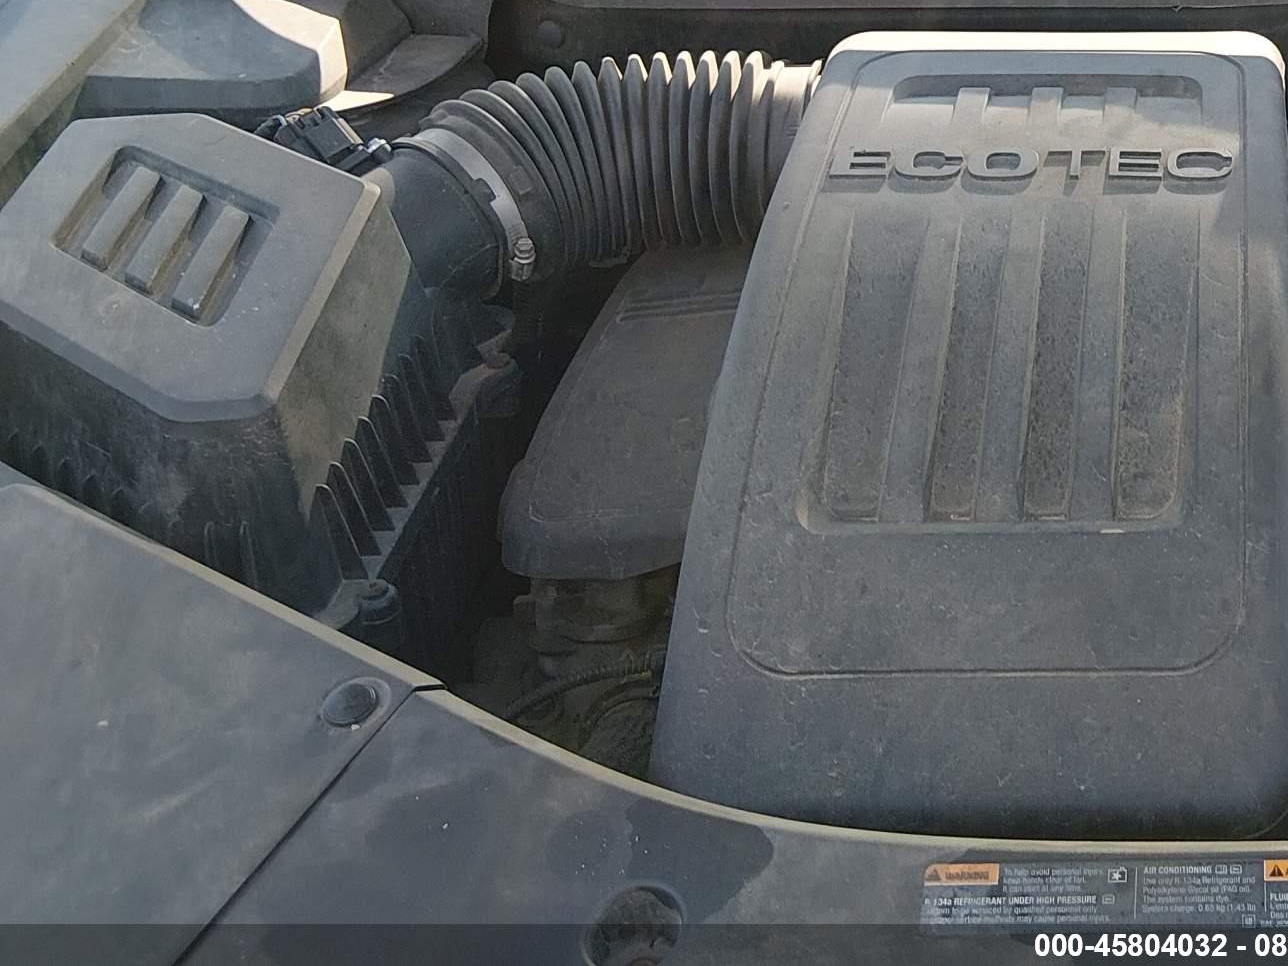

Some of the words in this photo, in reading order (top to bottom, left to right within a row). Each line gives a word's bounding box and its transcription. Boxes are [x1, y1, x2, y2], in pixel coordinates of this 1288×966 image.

[829, 146, 1234, 182] ECOTEC
[1143, 866, 1157, 874] AIR
[1158, 865, 1212, 874] CONDITIONING
[954, 896, 1006, 905] REFRIGERANT
[1007, 896, 1034, 905] UNDER
[1036, 895, 1056, 904] HIGH
[1057, 895, 1097, 904] PRESSURE
